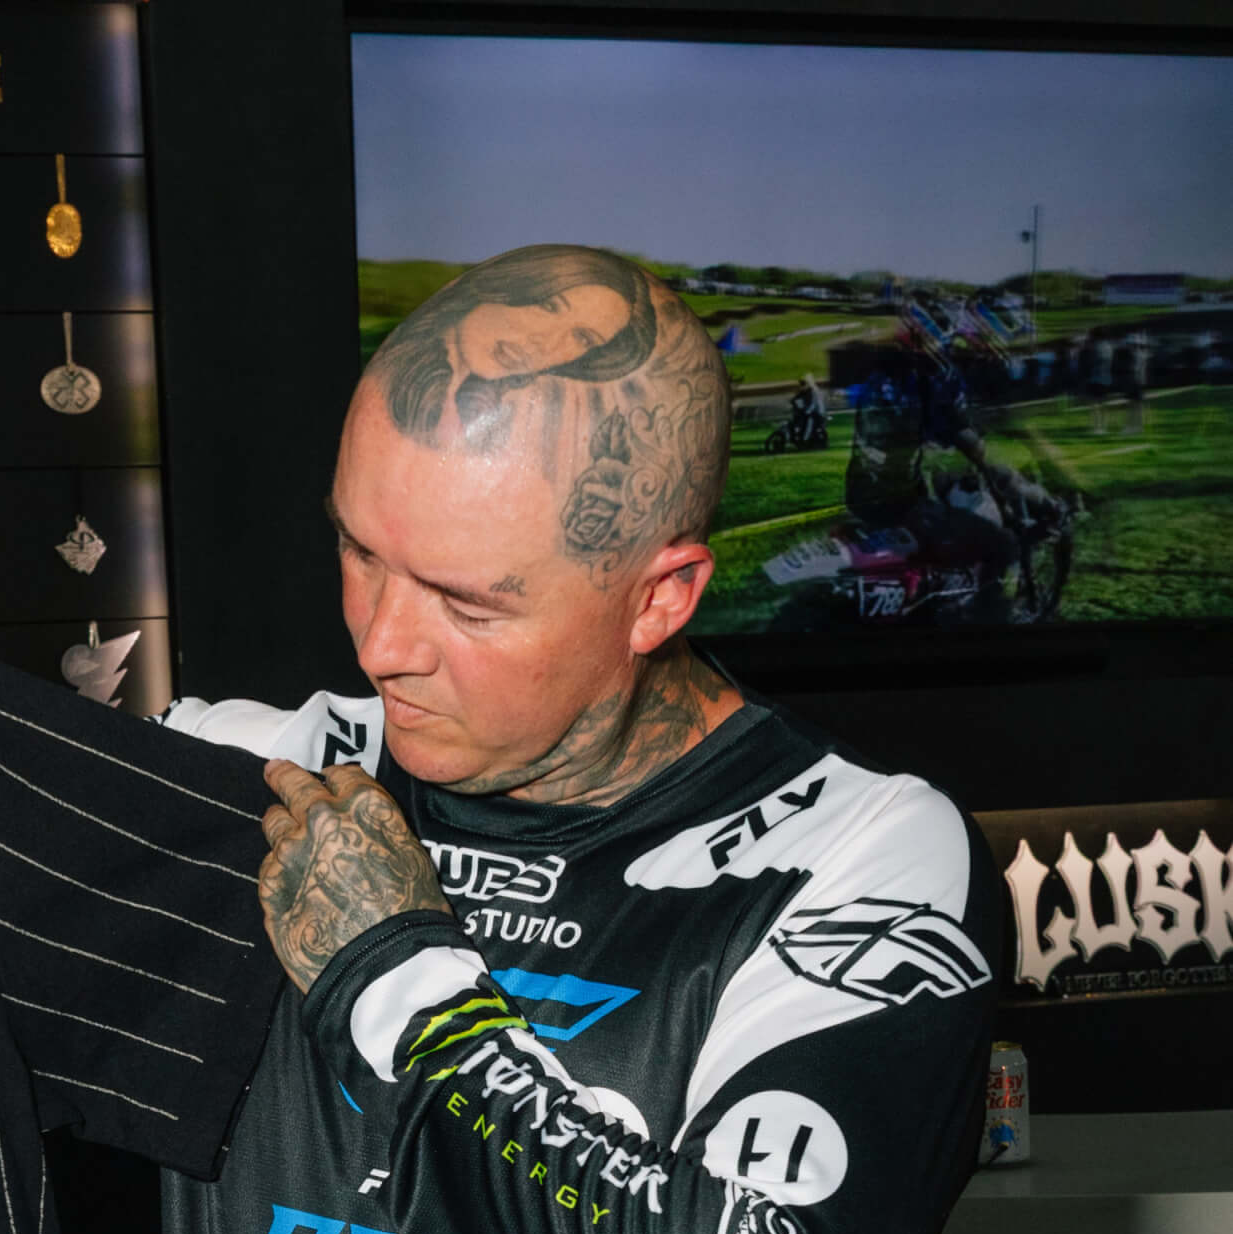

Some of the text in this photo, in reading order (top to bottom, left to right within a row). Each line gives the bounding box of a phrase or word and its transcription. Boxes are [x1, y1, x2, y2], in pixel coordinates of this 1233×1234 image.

[463, 907, 583, 950] STUDIO
[986, 1091, 1026, 1110] ider
[445, 1091, 610, 1225] ENERGY
